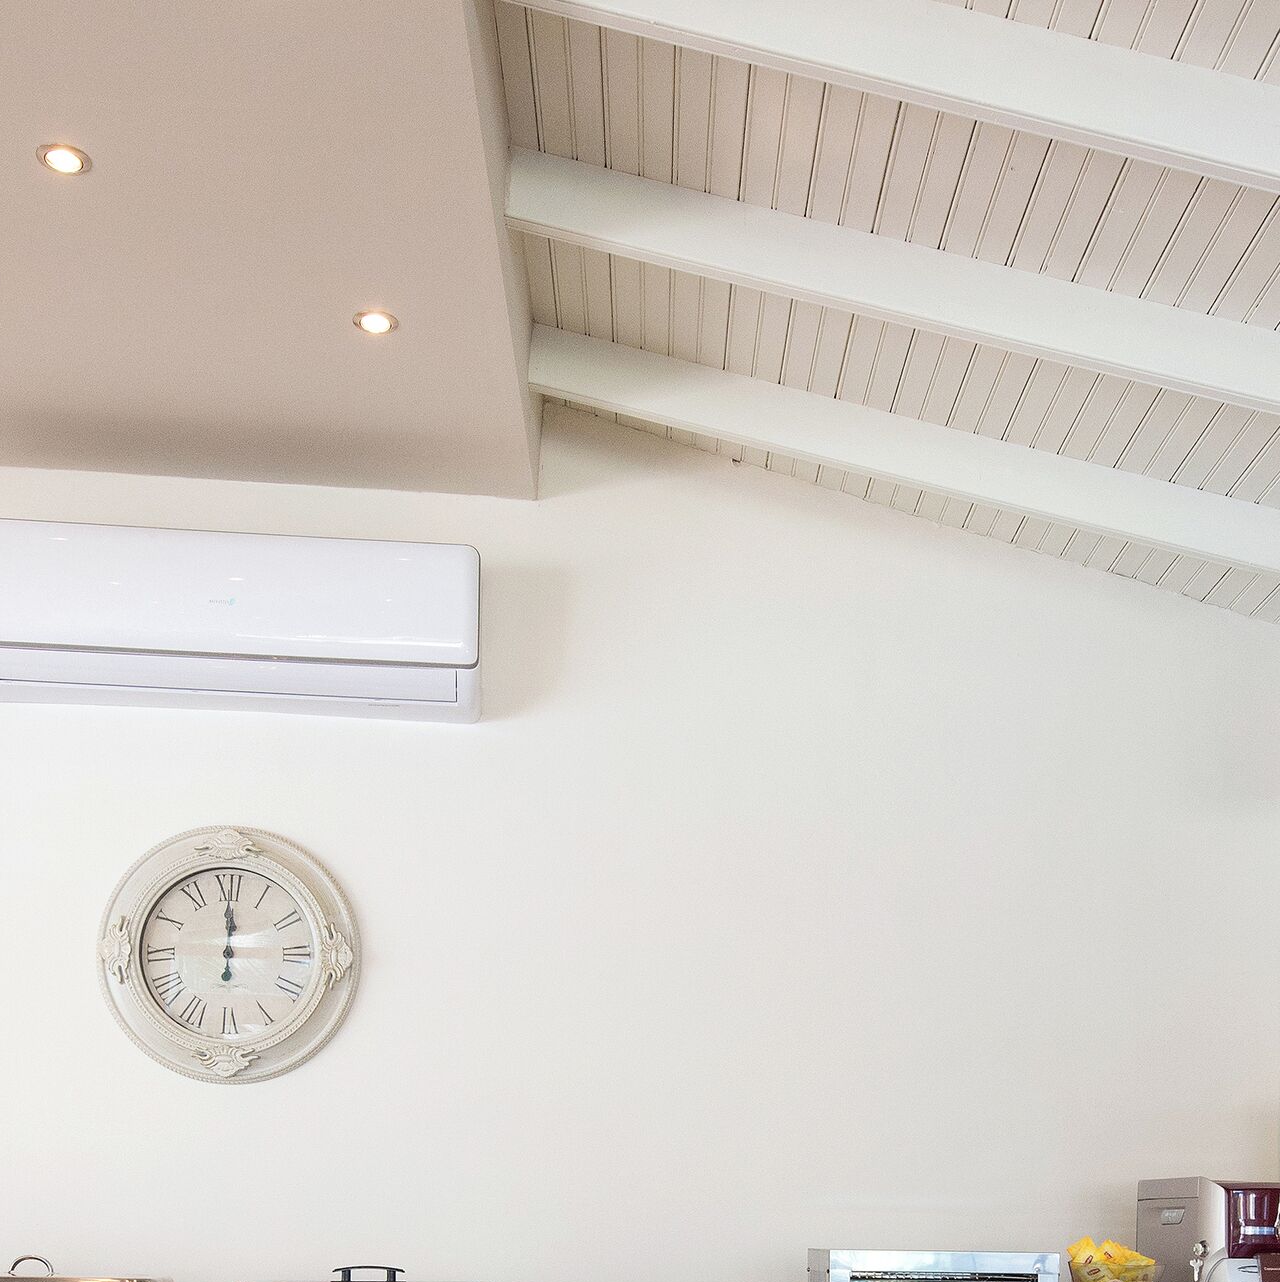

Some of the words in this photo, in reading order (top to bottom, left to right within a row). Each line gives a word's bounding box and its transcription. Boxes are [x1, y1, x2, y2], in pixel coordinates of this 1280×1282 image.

[180, 880, 207, 911] XI
[156, 909, 184, 931] X
[273, 909, 303, 931] II
[282, 944, 311, 967] III
[178, 995, 207, 1029] VII
